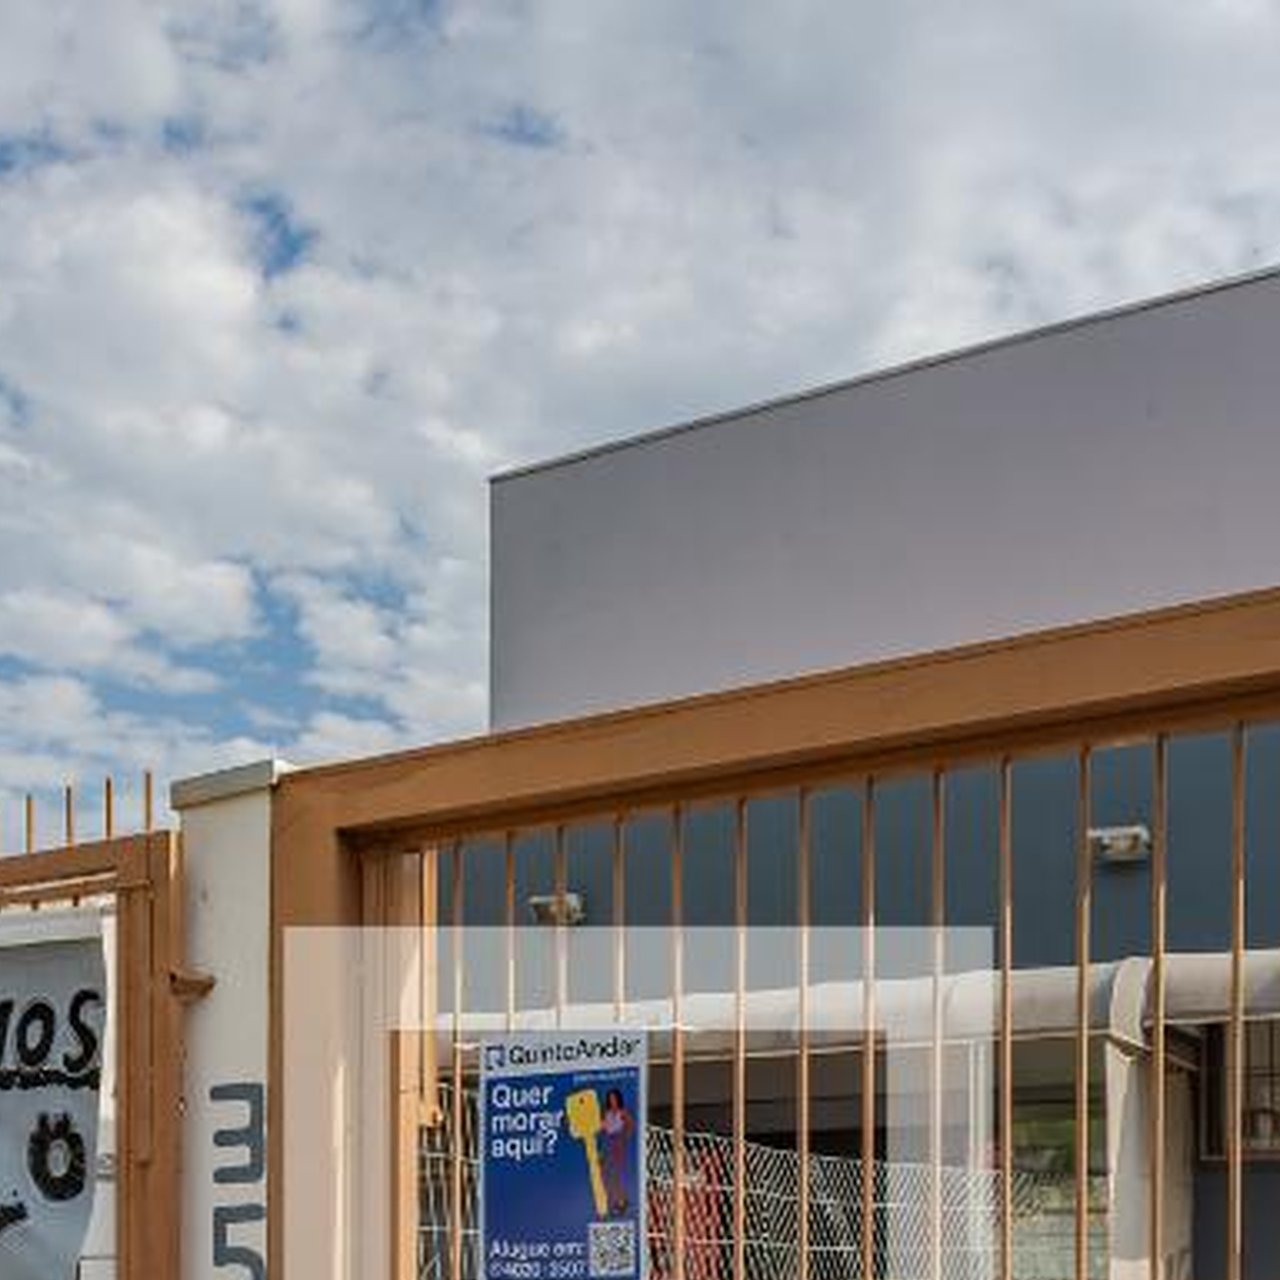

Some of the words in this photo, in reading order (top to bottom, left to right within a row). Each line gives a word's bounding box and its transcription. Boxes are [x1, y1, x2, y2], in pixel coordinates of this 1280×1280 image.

[492, 1084, 554, 1108] Quer
[492, 1110, 564, 1134] morar
[492, 1129, 558, 1161] aqui?
